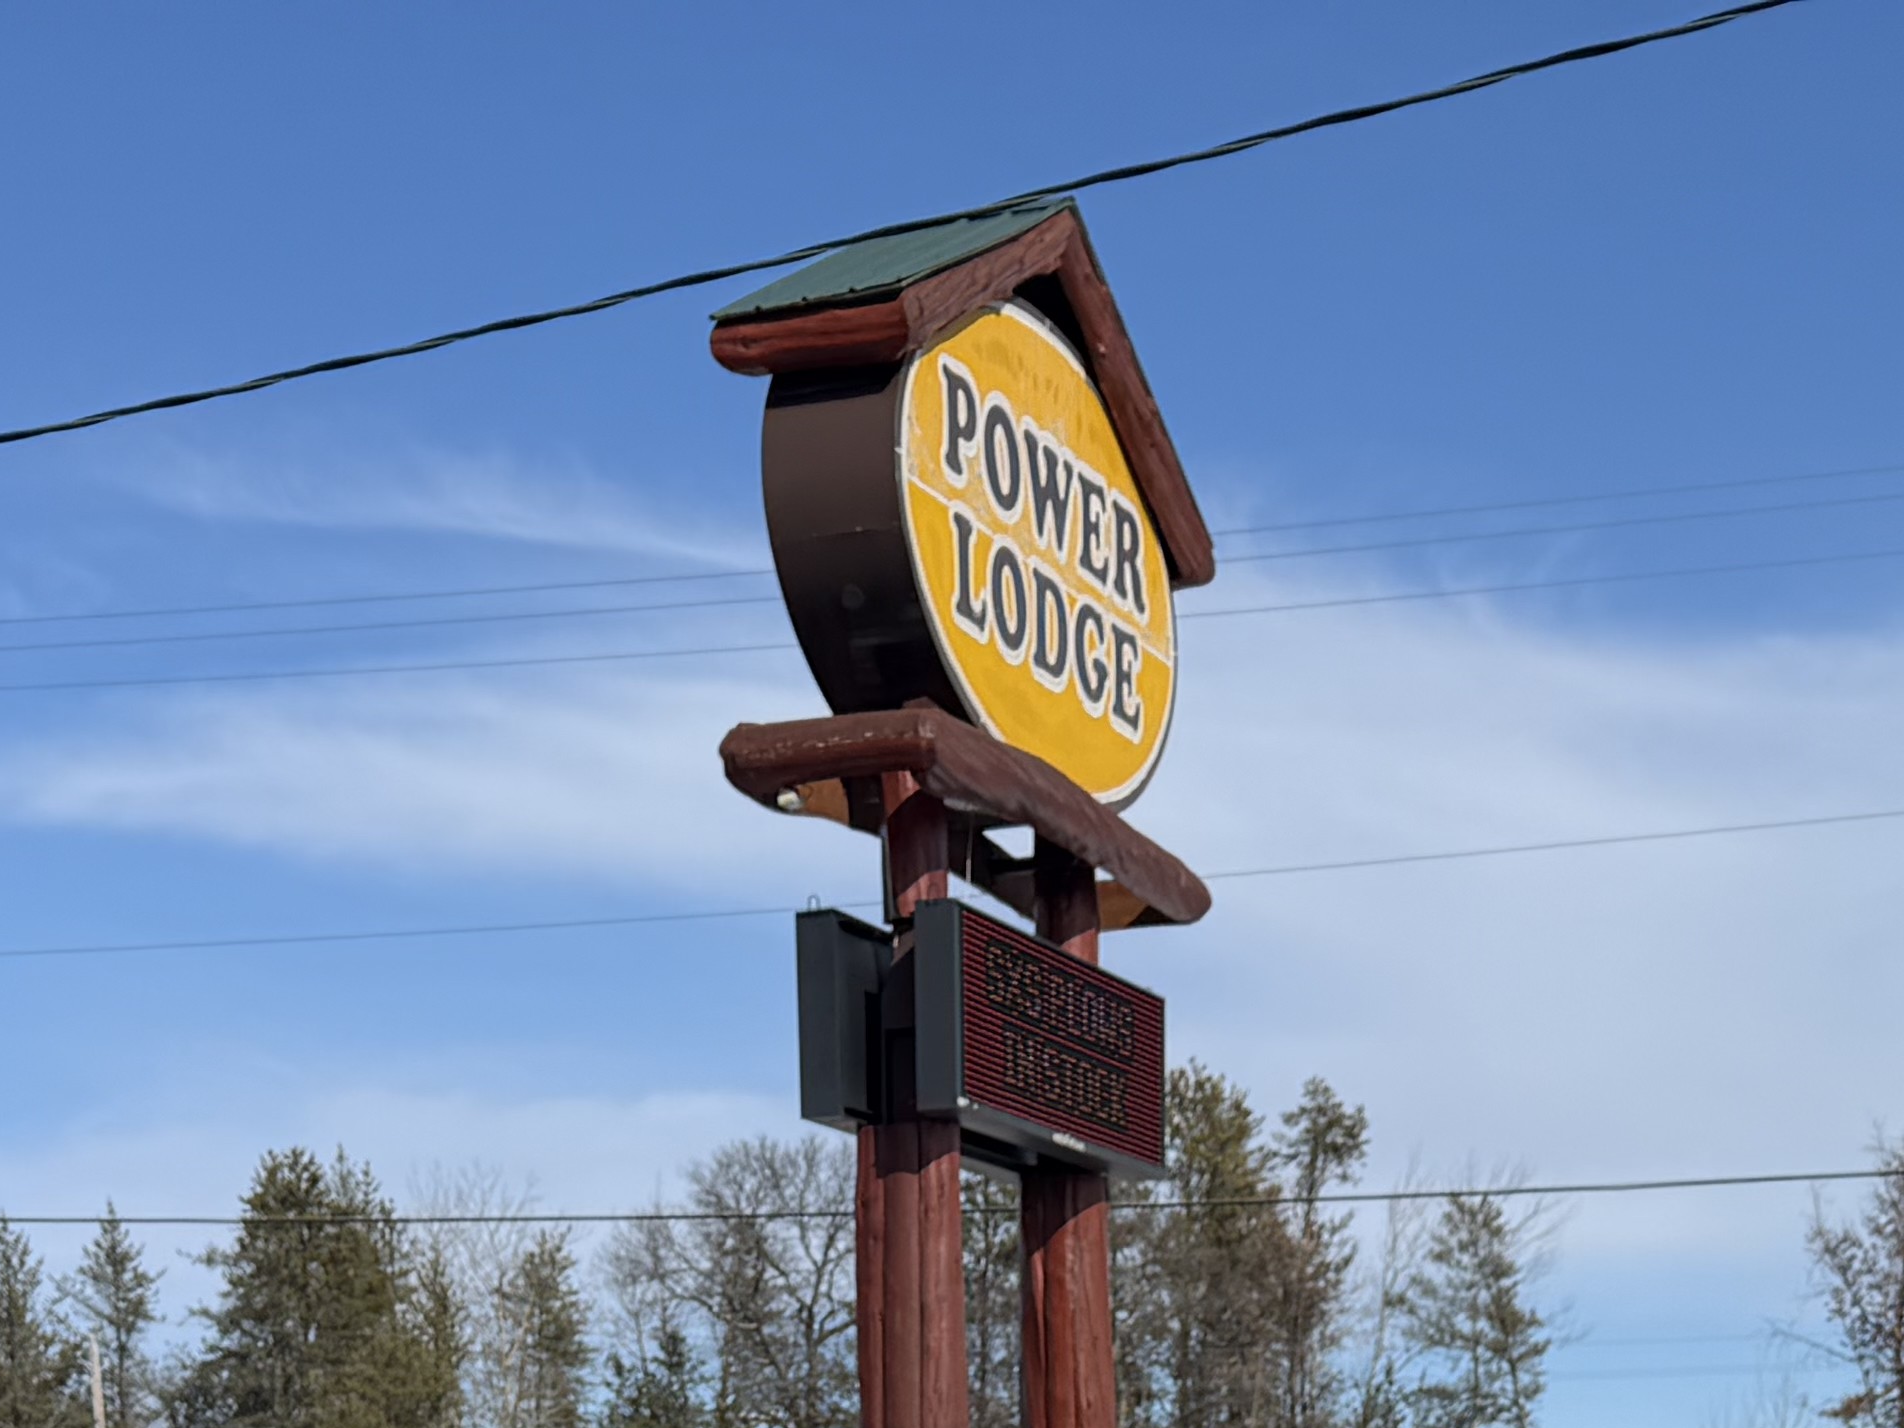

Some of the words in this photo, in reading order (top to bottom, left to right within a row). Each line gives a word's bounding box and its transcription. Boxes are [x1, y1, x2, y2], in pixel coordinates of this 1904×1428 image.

[942, 358, 1147, 620] POWER
[951, 510, 1142, 738] LODGE
[1004, 1027, 1033, 1093] IN
[1043, 1043, 1126, 1128] STOCK
[1051, 970, 1133, 1059] PLOWS
